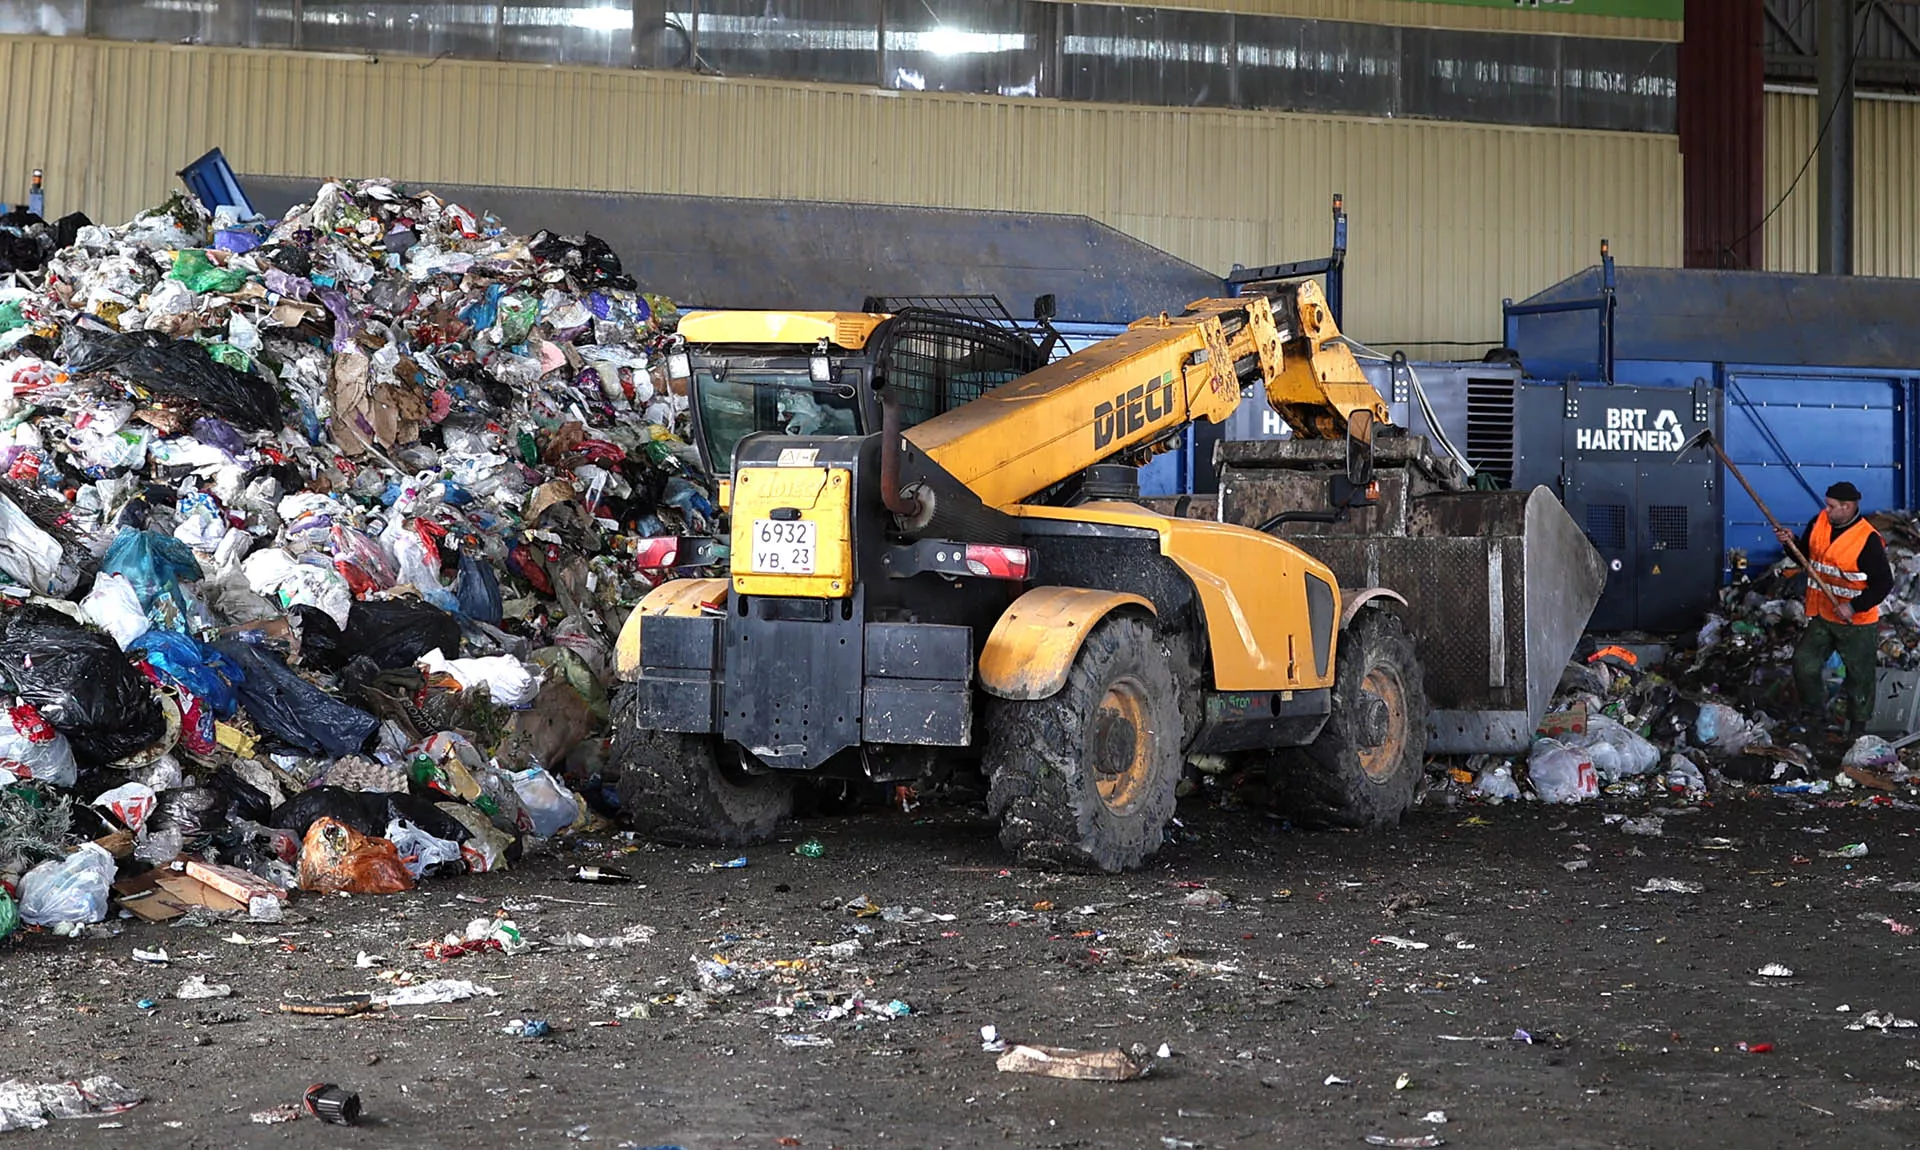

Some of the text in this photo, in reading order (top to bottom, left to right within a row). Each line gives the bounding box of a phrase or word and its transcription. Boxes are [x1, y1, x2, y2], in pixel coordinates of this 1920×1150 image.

[1094, 369, 1173, 451] DIECI
[1607, 408, 1648, 429] BRT
[1577, 428, 1673, 452] HARTNER
[761, 523, 807, 544] 6932
[758, 548, 809, 568] УВ 23
